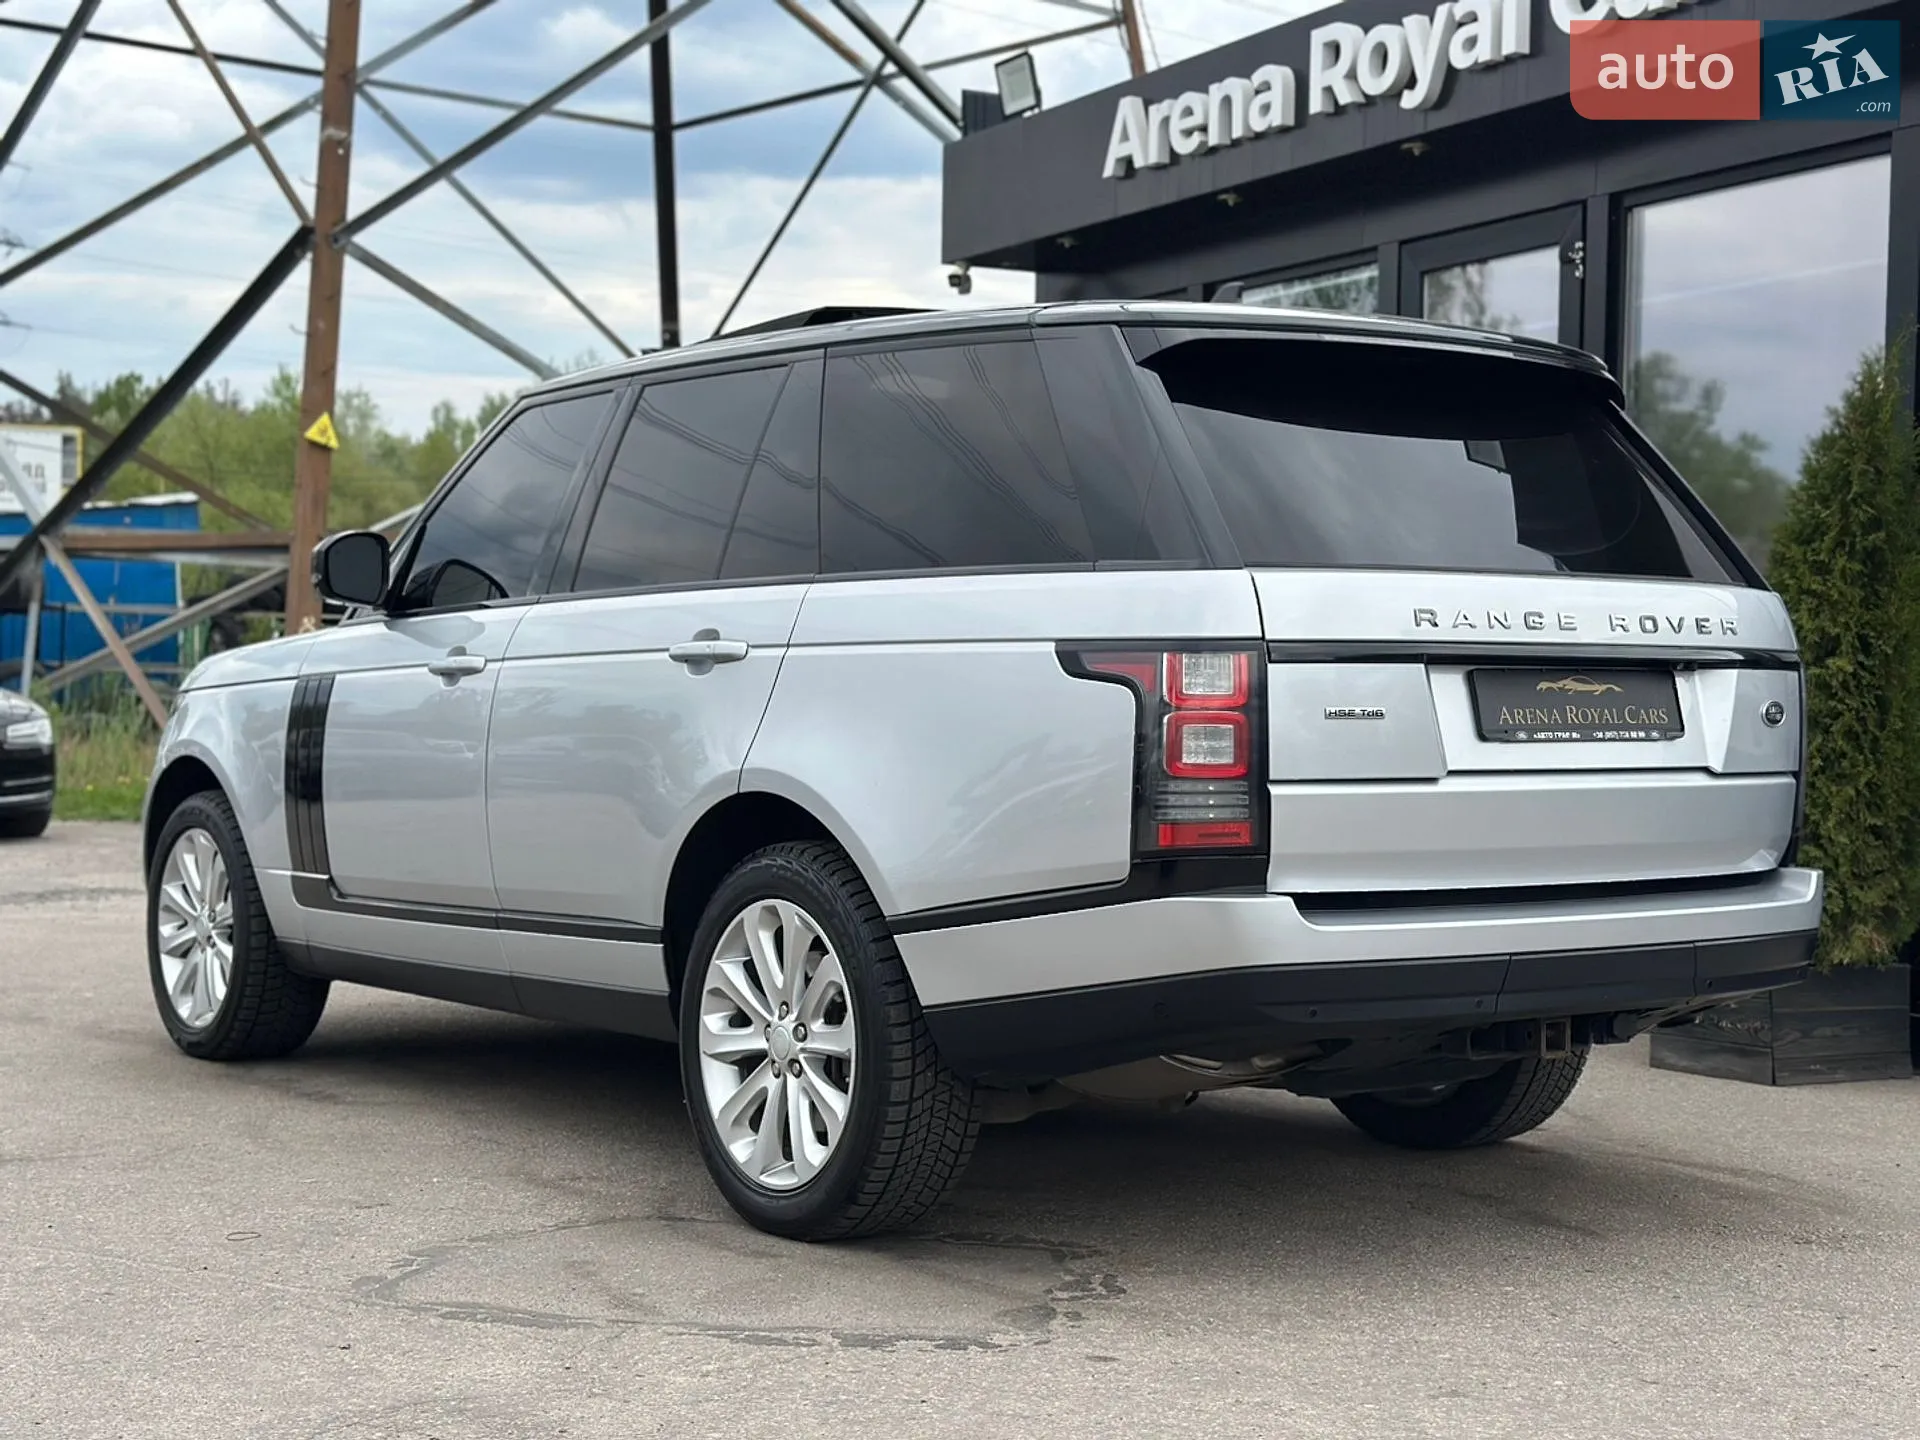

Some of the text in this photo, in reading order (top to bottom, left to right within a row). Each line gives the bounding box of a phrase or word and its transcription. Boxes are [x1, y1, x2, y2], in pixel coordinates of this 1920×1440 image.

[1102, 0, 1531, 179] Arena Royal
[1413, 607, 1739, 637] RANGE ROVER
[1327, 708, 1385, 718] HSE Td6
[1499, 705, 1669, 725] ARENA ROYAL CARS
